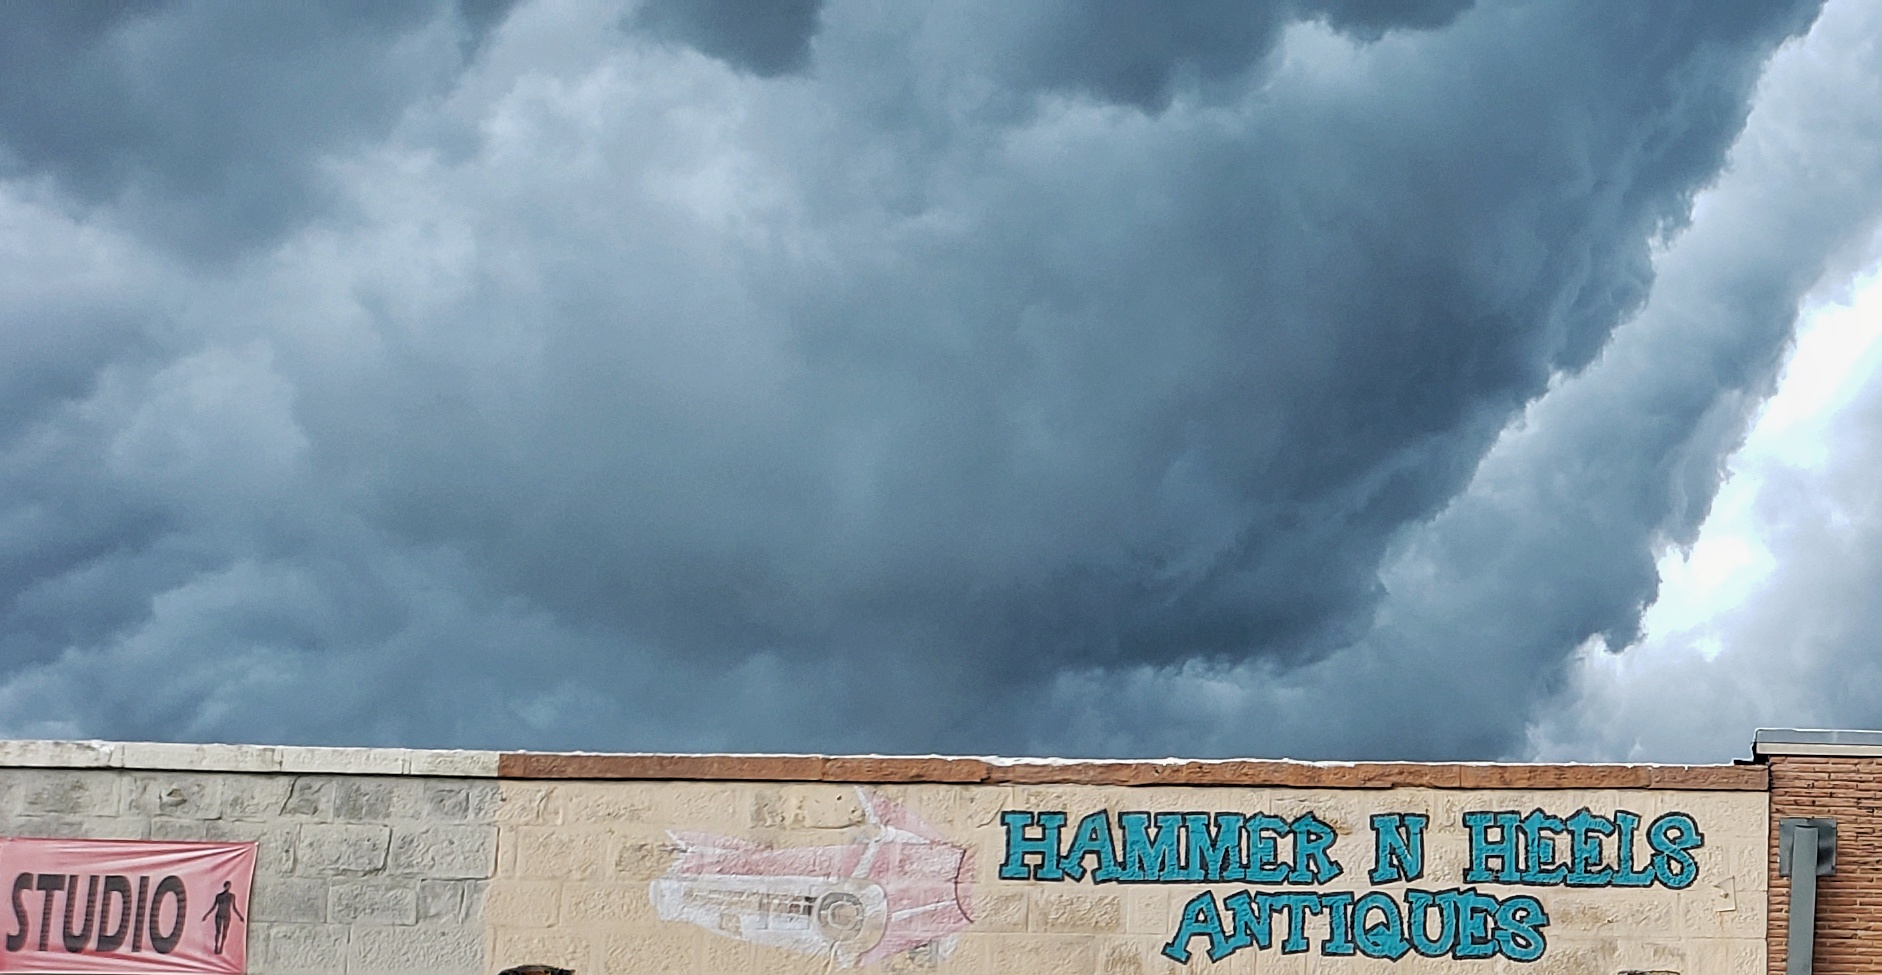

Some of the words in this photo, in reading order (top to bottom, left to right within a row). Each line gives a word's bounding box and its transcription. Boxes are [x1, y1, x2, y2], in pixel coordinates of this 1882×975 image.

[1000, 809, 1342, 885] HAMMER
[1370, 813, 1429, 885] N
[1463, 808, 1706, 890] HEELS
[6, 871, 188, 955] STUDIO
[1162, 887, 1550, 964] ANTIQUES
